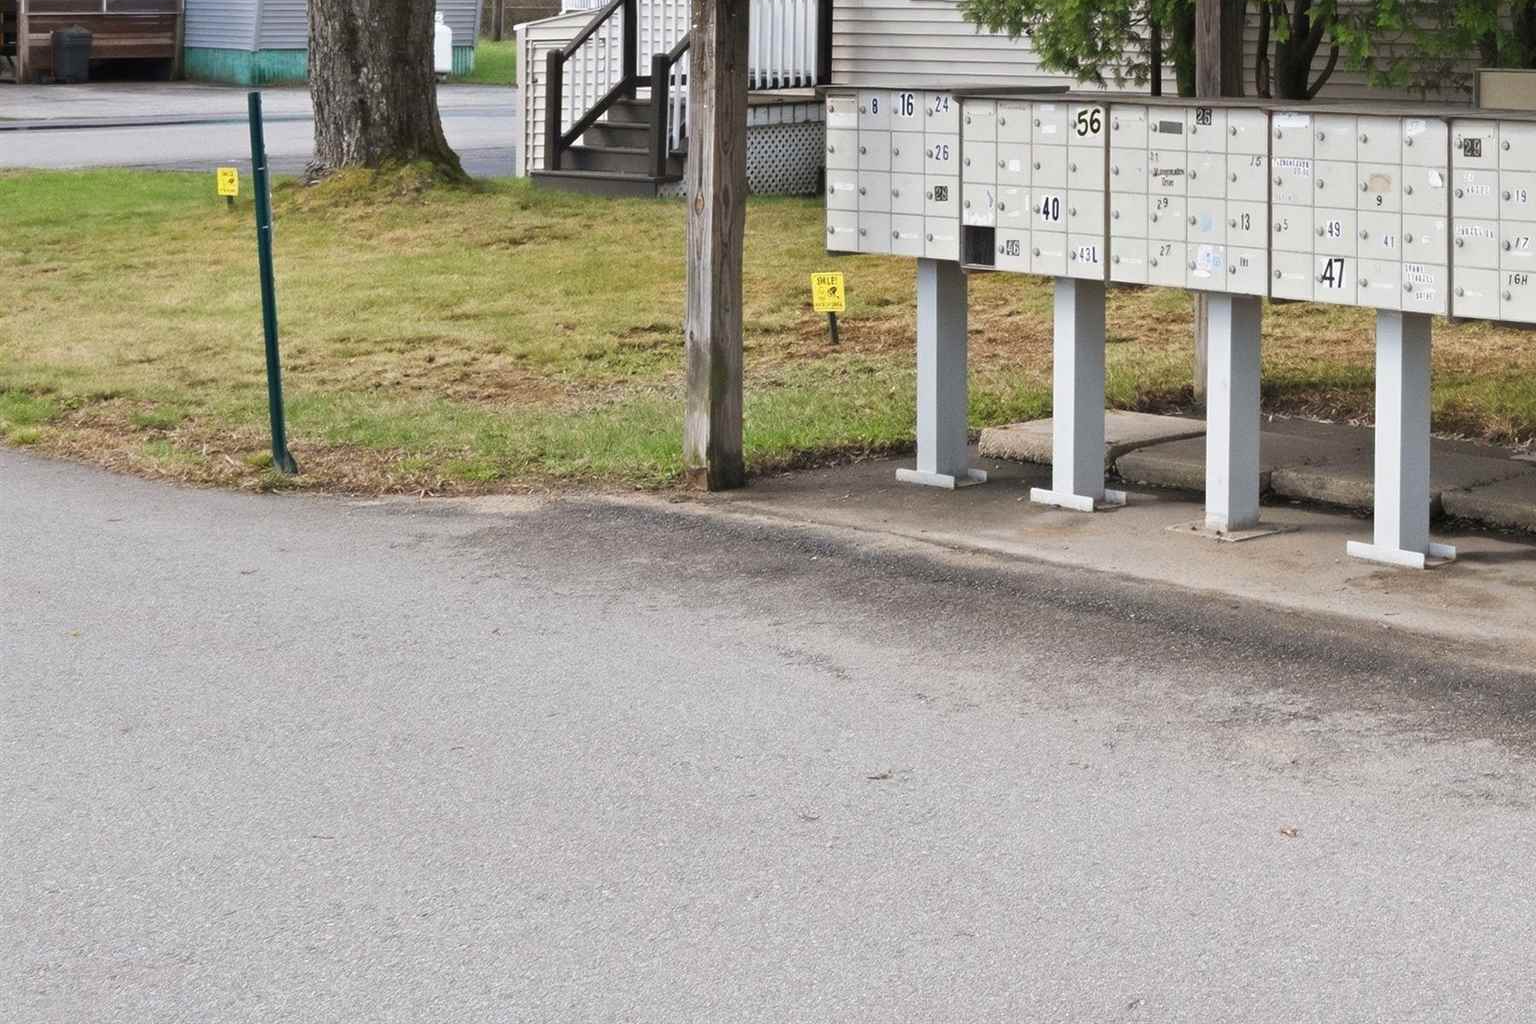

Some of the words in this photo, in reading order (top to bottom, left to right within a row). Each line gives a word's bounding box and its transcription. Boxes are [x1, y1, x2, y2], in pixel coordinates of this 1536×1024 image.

[871, 98, 879, 114] 8
[900, 94, 914, 116] 16
[935, 96, 949, 112] 24
[1077, 108, 1101, 136] 56
[935, 144, 949, 160] 26
[1376, 195, 1383, 206] 9
[1515, 190, 1527, 203] 19
[1042, 197, 1060, 221] 40
[1240, 213, 1251, 231] 13
[1327, 221, 1341, 237] 49
[1321, 258, 1345, 288] 47
